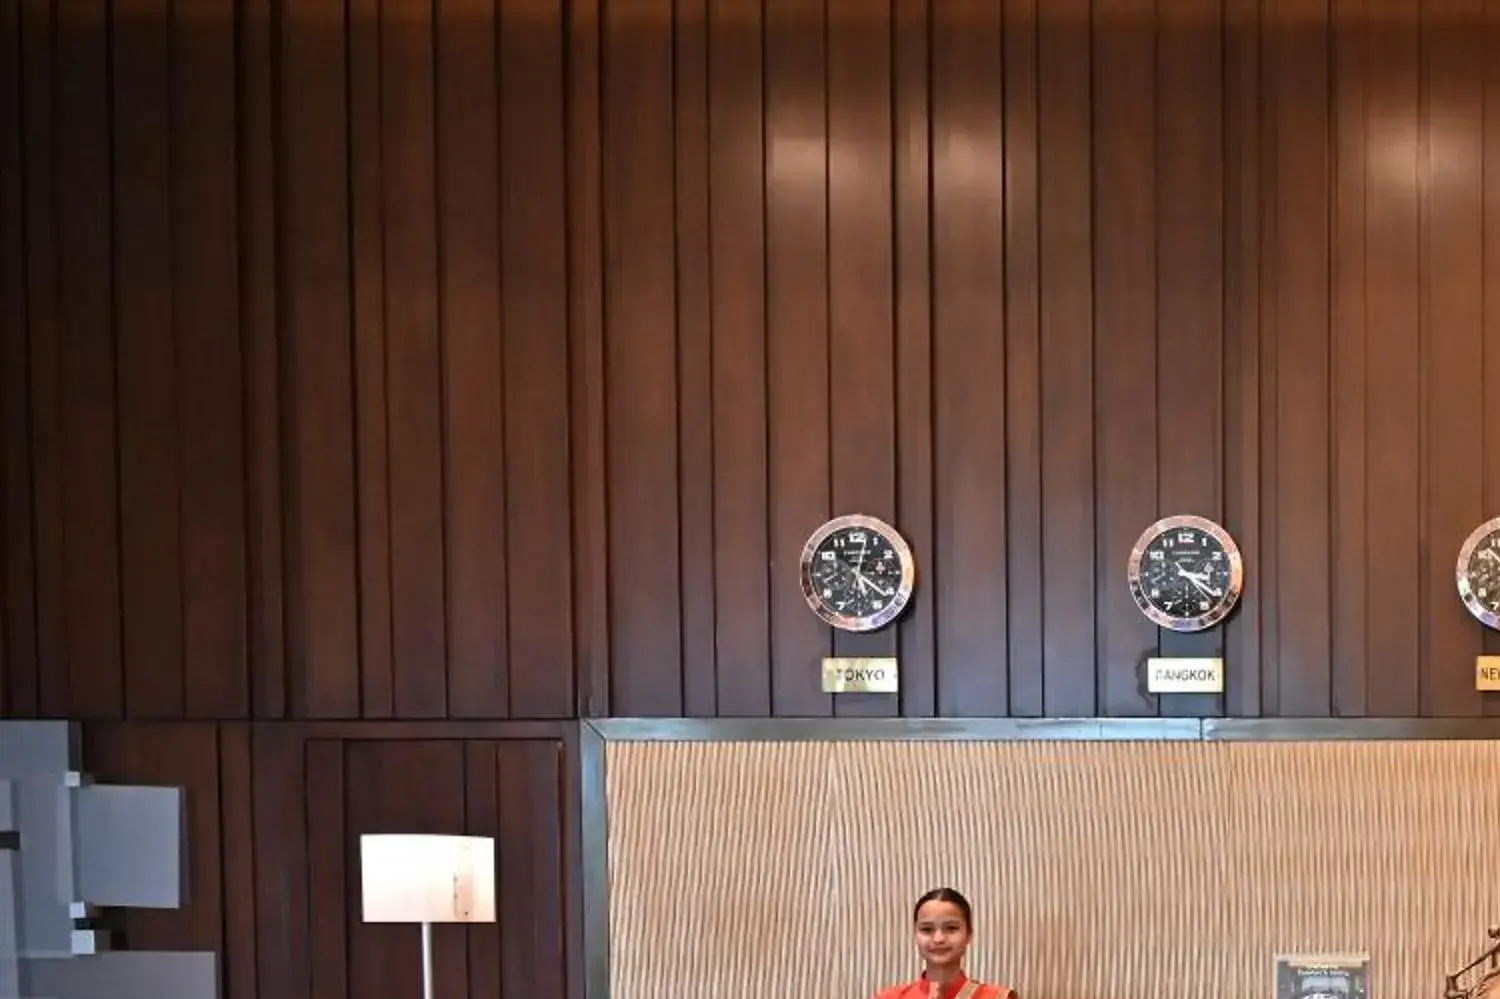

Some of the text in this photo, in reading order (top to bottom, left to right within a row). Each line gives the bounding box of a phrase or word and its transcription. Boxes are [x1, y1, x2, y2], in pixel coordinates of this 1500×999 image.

[836, 601, 845, 611] 7
[1164, 601, 1173, 611] 7
[1491, 601, 1499, 611] 7
